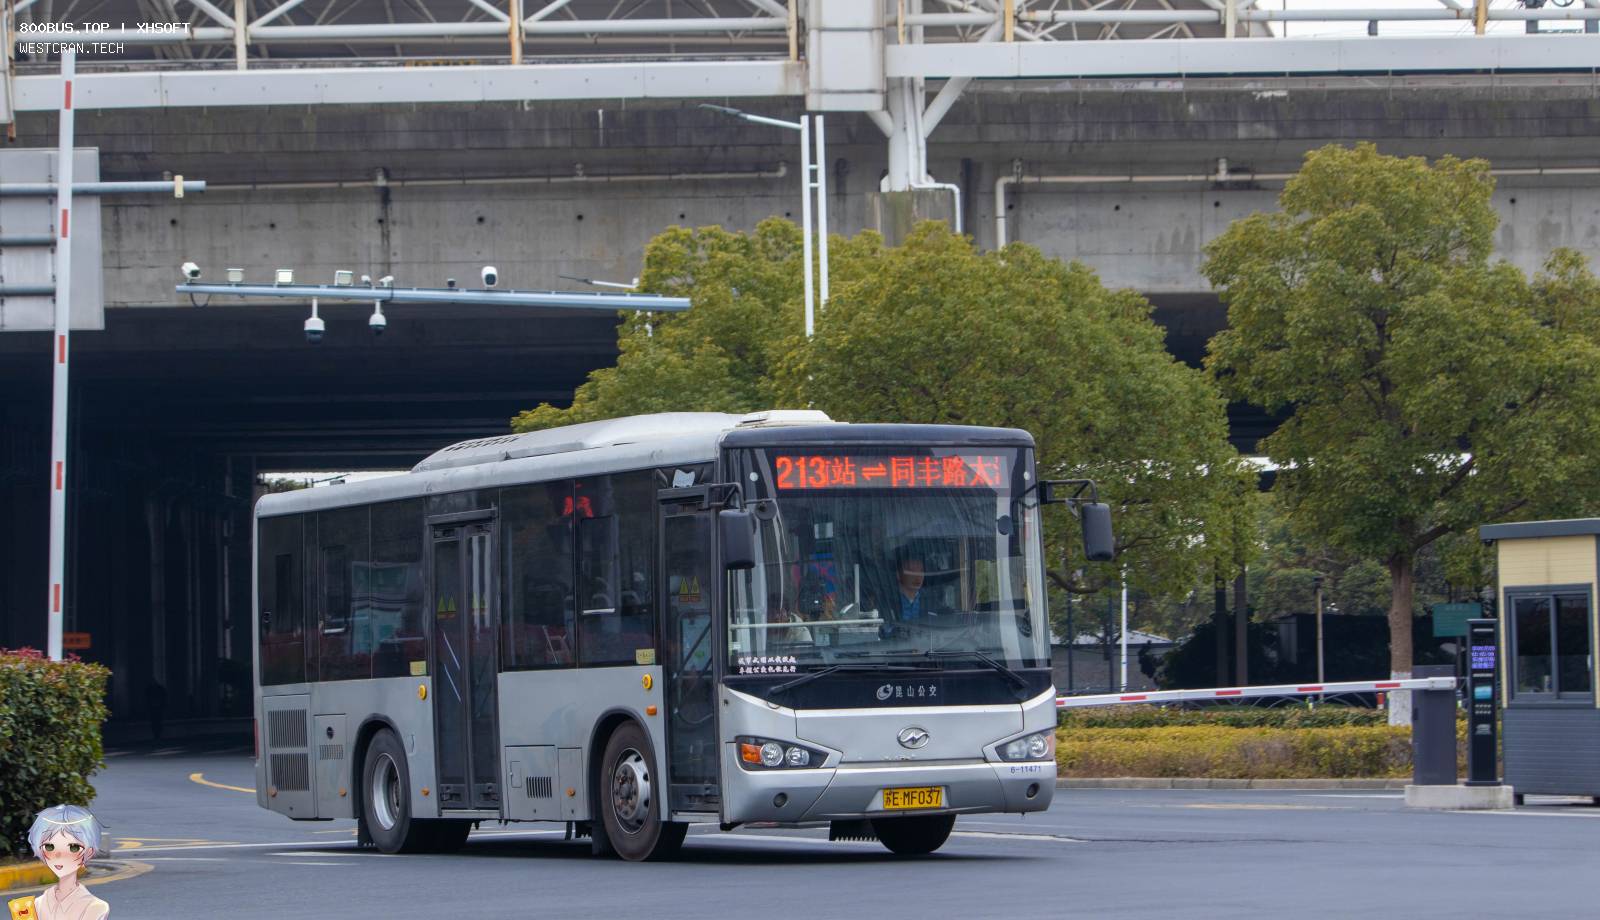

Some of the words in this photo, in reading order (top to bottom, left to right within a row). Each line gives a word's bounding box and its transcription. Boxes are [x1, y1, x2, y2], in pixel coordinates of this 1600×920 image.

[776, 455, 826, 490] 213
[891, 455, 1001, 488] 同丰路大
[895, 684, 937, 698] 昆山公交
[1010, 765, 1041, 774] 6-11471
